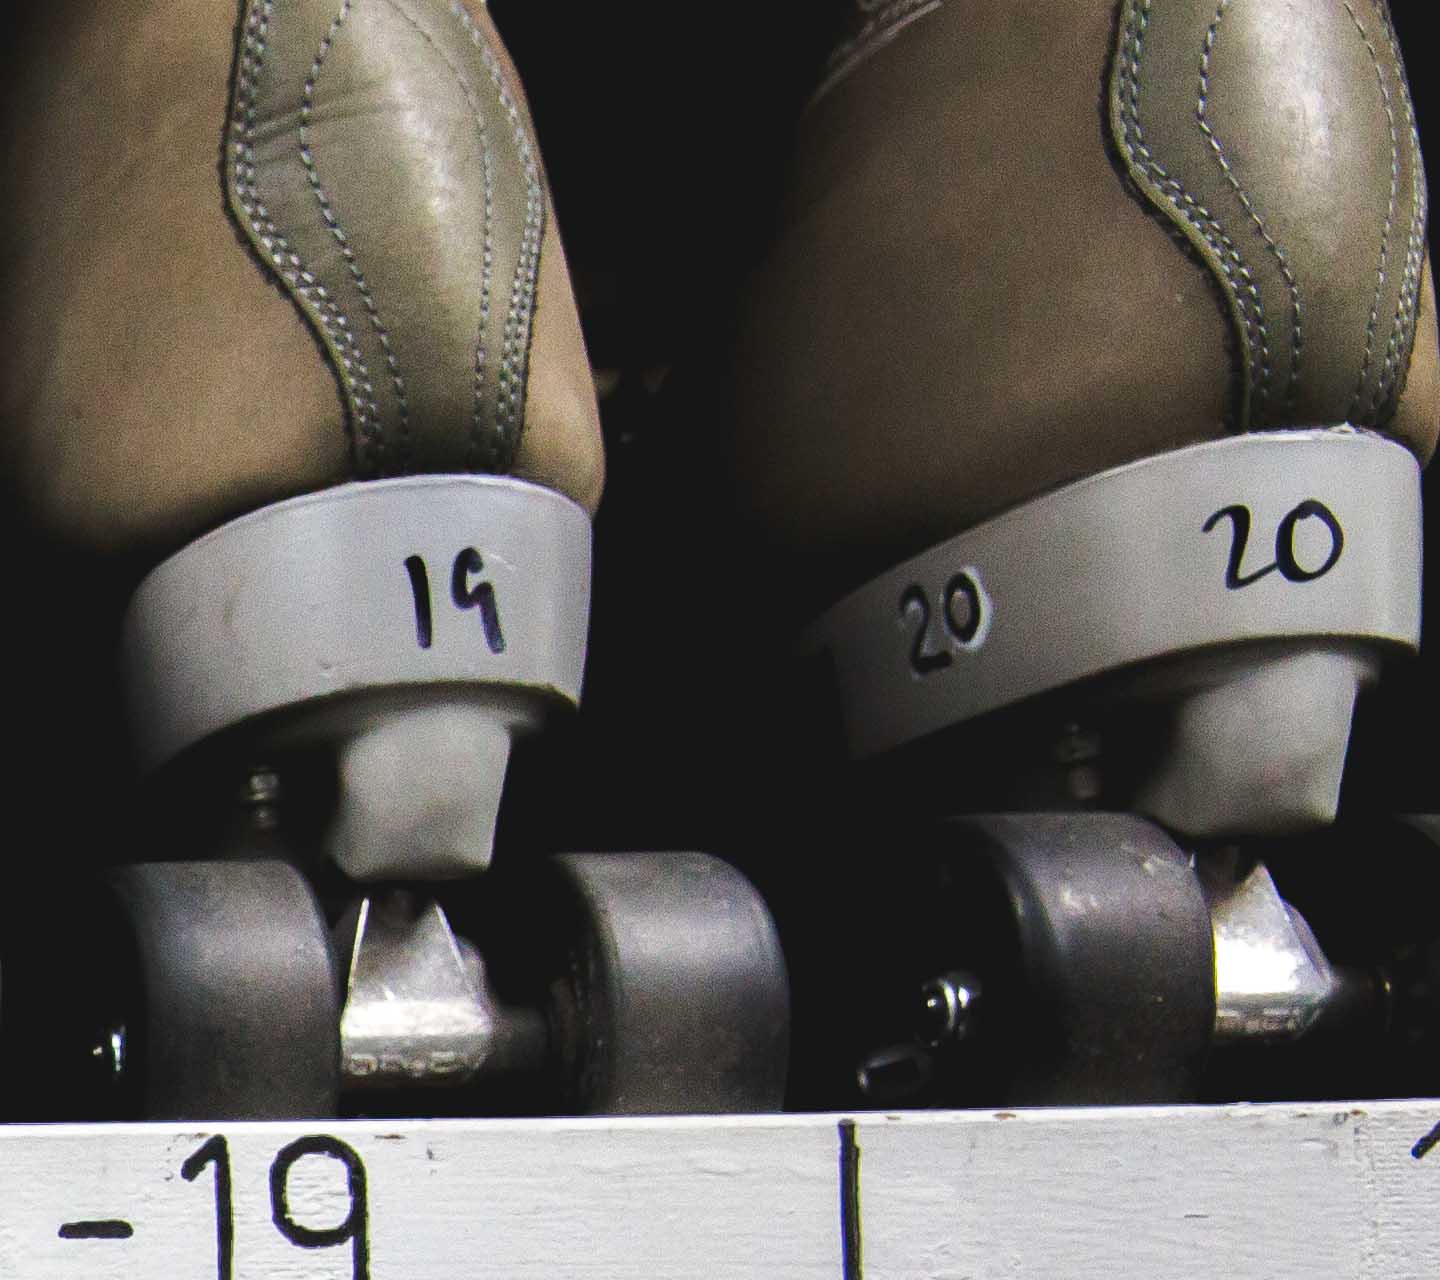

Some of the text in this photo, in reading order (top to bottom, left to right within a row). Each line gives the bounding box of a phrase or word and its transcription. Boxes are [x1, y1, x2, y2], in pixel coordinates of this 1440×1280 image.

[1202, 499, 1344, 590] 20
[403, 546, 505, 654] 19
[897, 570, 986, 675] 20
